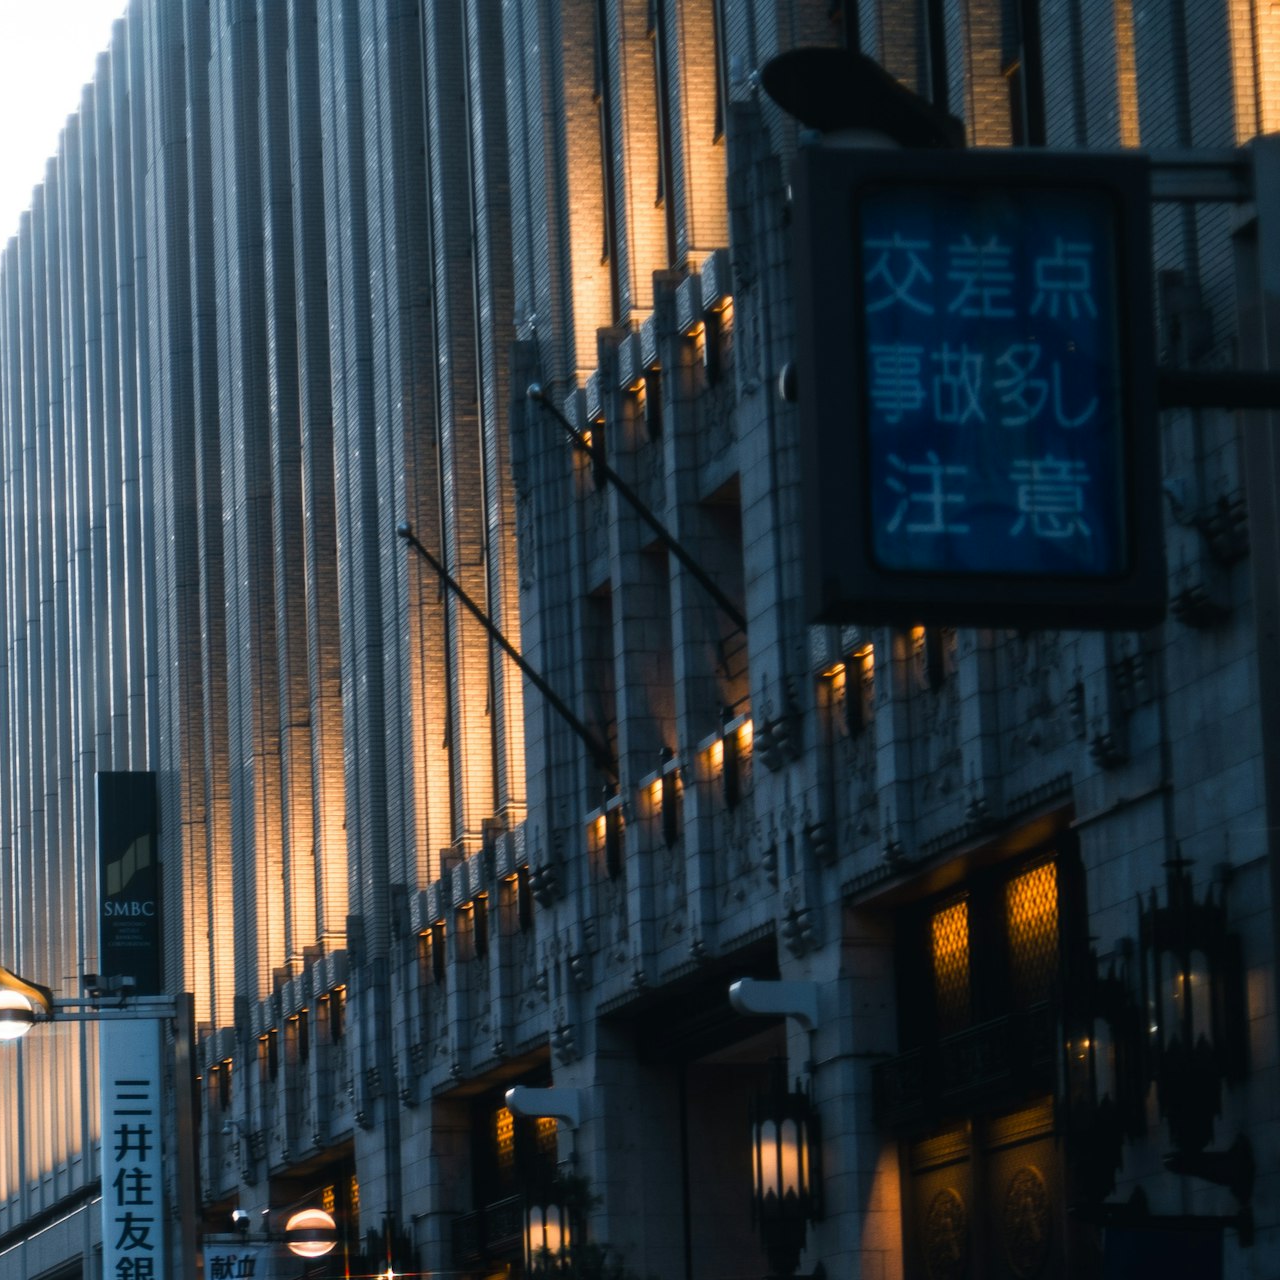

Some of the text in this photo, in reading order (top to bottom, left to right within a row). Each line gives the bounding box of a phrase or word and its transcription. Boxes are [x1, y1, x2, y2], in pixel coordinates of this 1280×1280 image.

[862, 233, 1099, 321] 交差点
[867, 341, 1099, 430] 事故多し
[882, 452, 1092, 540] 注意
[104, 901, 155, 917] SMBC
[209, 1254, 256, 1280] 献血
